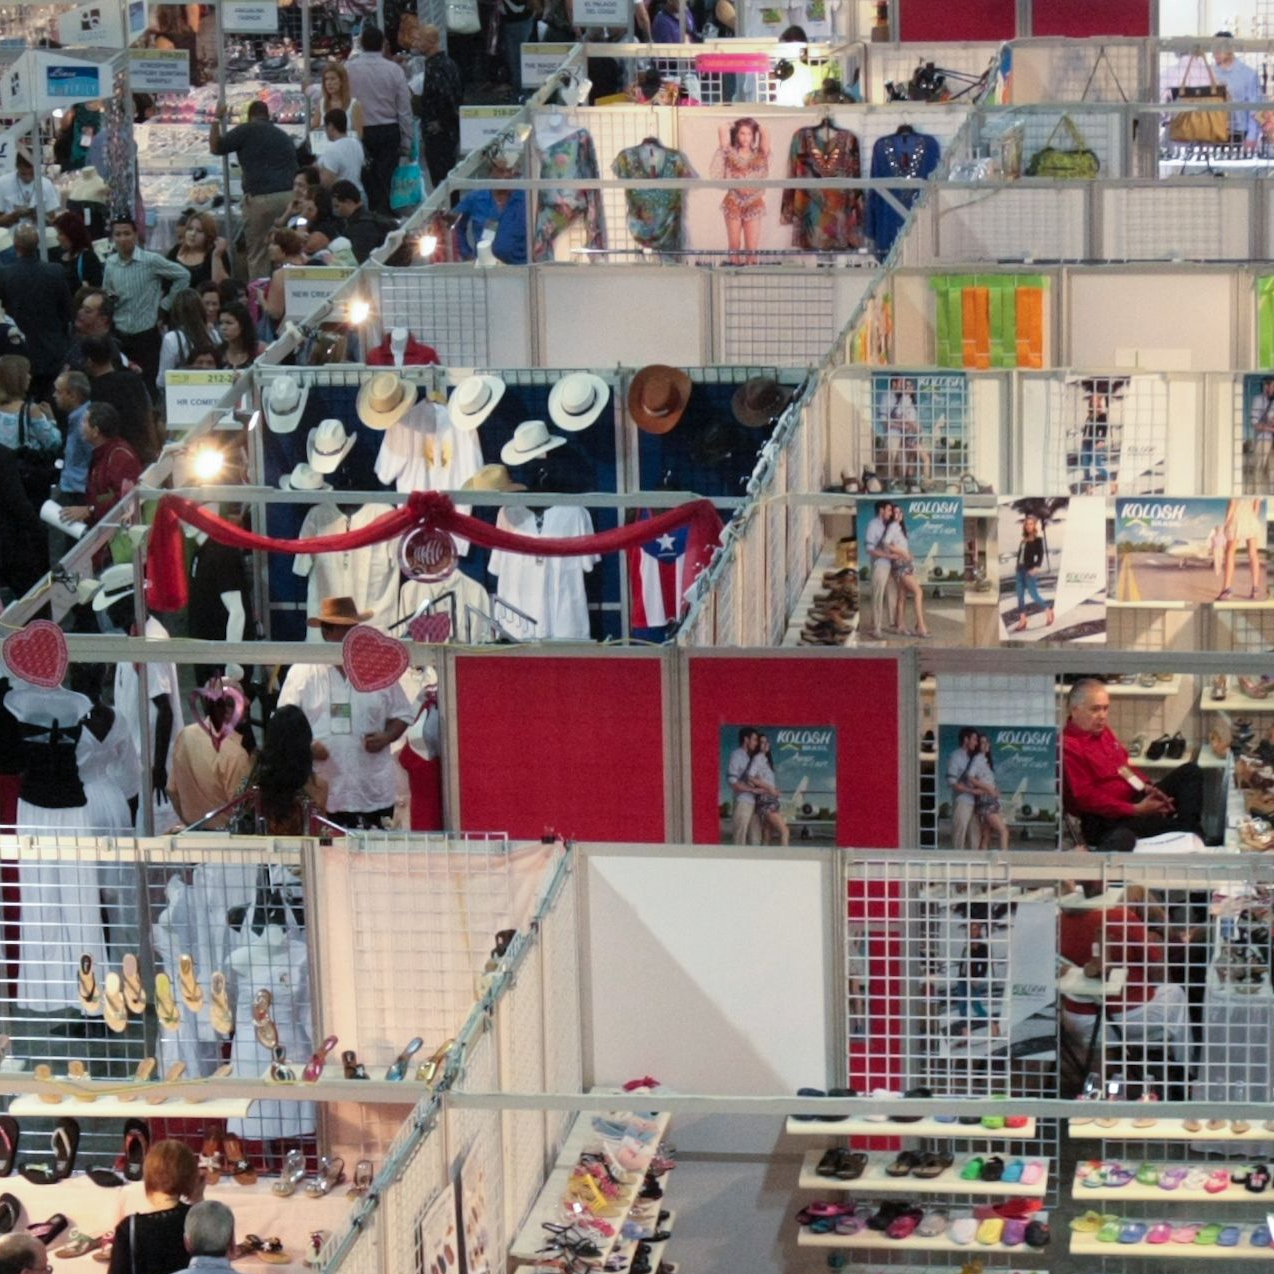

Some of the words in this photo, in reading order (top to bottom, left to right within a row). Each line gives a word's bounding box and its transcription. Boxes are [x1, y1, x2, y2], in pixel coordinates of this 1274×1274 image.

[908, 502, 960, 514] KOLOSH
[1120, 504, 1186, 521] KOLOSH
[776, 730, 833, 745] KOLOSH
[995, 730, 1053, 745] KOLOSH
